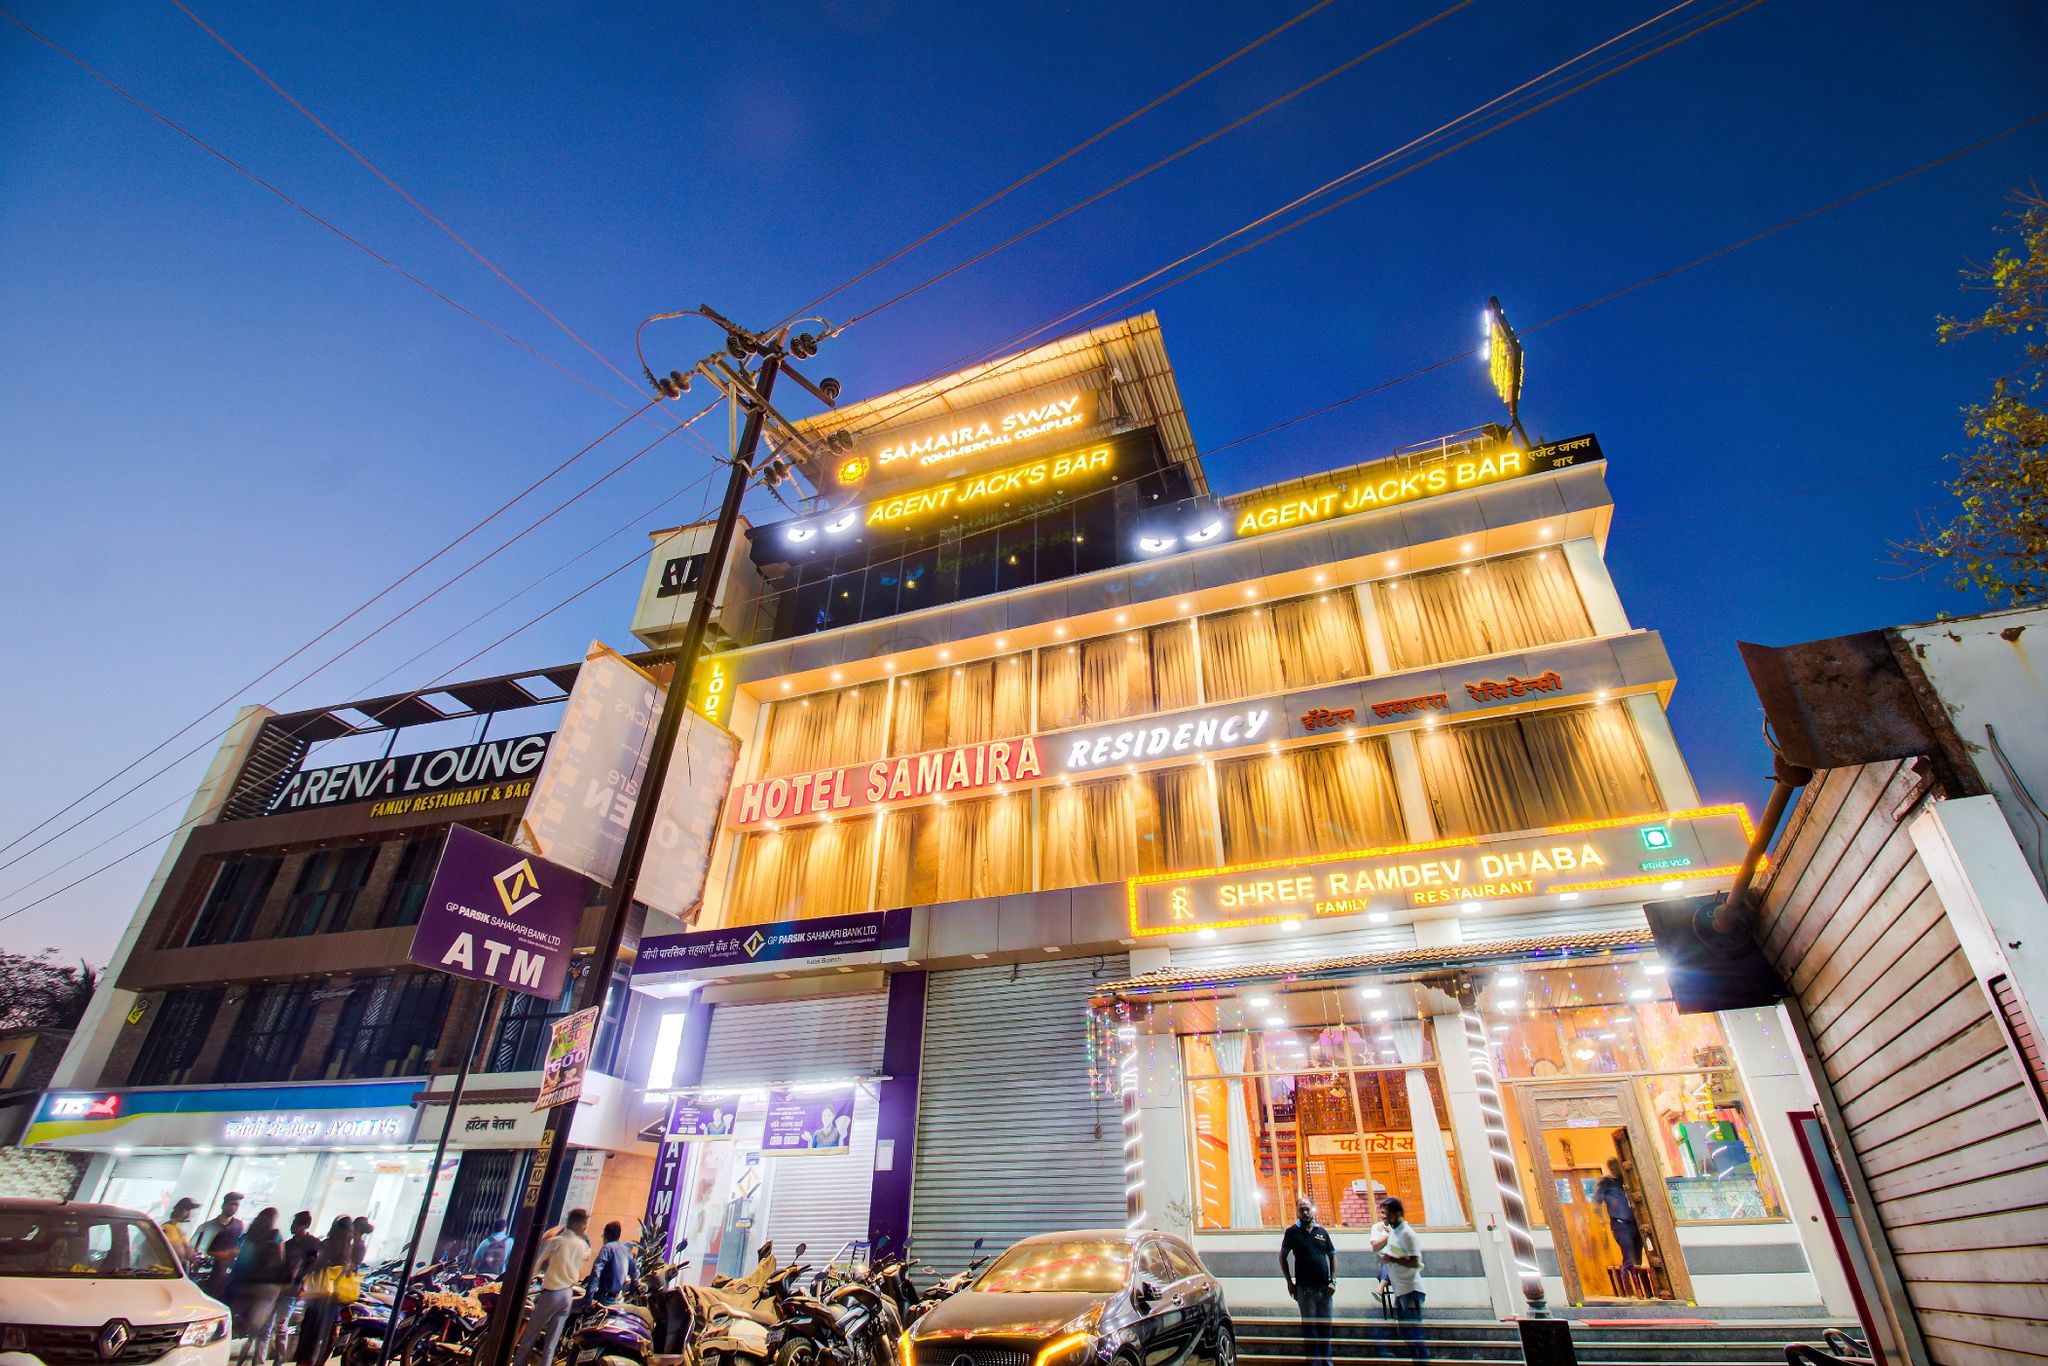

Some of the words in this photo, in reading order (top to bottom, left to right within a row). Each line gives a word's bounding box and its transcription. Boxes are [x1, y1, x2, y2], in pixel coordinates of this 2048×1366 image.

[879, 424, 994, 465] SAMAIRA
[1001, 396, 1079, 431] SWAY
[920, 435, 1012, 466] COMMERCIAL
[1014, 412, 1083, 441] COMPLEX
[867, 489, 953, 524] AGENT
[957, 465, 1048, 502] JACK'S
[1052, 448, 1111, 482] BAR
[1237, 493, 1338, 535] AGENT
[1342, 468, 1447, 510] JACK'S
[1456, 450, 1521, 486] BAR
[271, 758, 397, 810] ARENA
[403, 736, 548, 792] LOUNG
[739, 769, 852, 824] HOTEL
[866, 737, 1042, 803] SAMAIRA
[1067, 708, 1269, 769] RESIDENCY
[370, 799, 411, 818] FAMILY
[412, 787, 490, 812] RESTAURANT
[491, 786, 502, 801] &
[504, 782, 532, 799] BAR
[1219, 876, 1315, 908] SHREE
[1329, 858, 1462, 896] RAMDEV
[1480, 843, 1604, 880] DHABA
[1642, 860, 1669, 871] PURE
[1669, 858, 1692, 867] VEG
[446, 902, 459, 913] GP
[458, 905, 491, 924] PARSIK
[490, 916, 528, 935] SAHAKARI
[527, 928, 548, 942] BANK
[548, 935, 560, 946] LTD
[1315, 897, 1369, 915] FAMILY
[1414, 879, 1534, 904] RESTAURANT
[441, 931, 546, 989] ATM
[767, 936, 778, 946] GP
[778, 933, 805, 944] PARSIK
[806, 929, 842, 942] SAHAKARI
[842, 927, 862, 938] BANK
